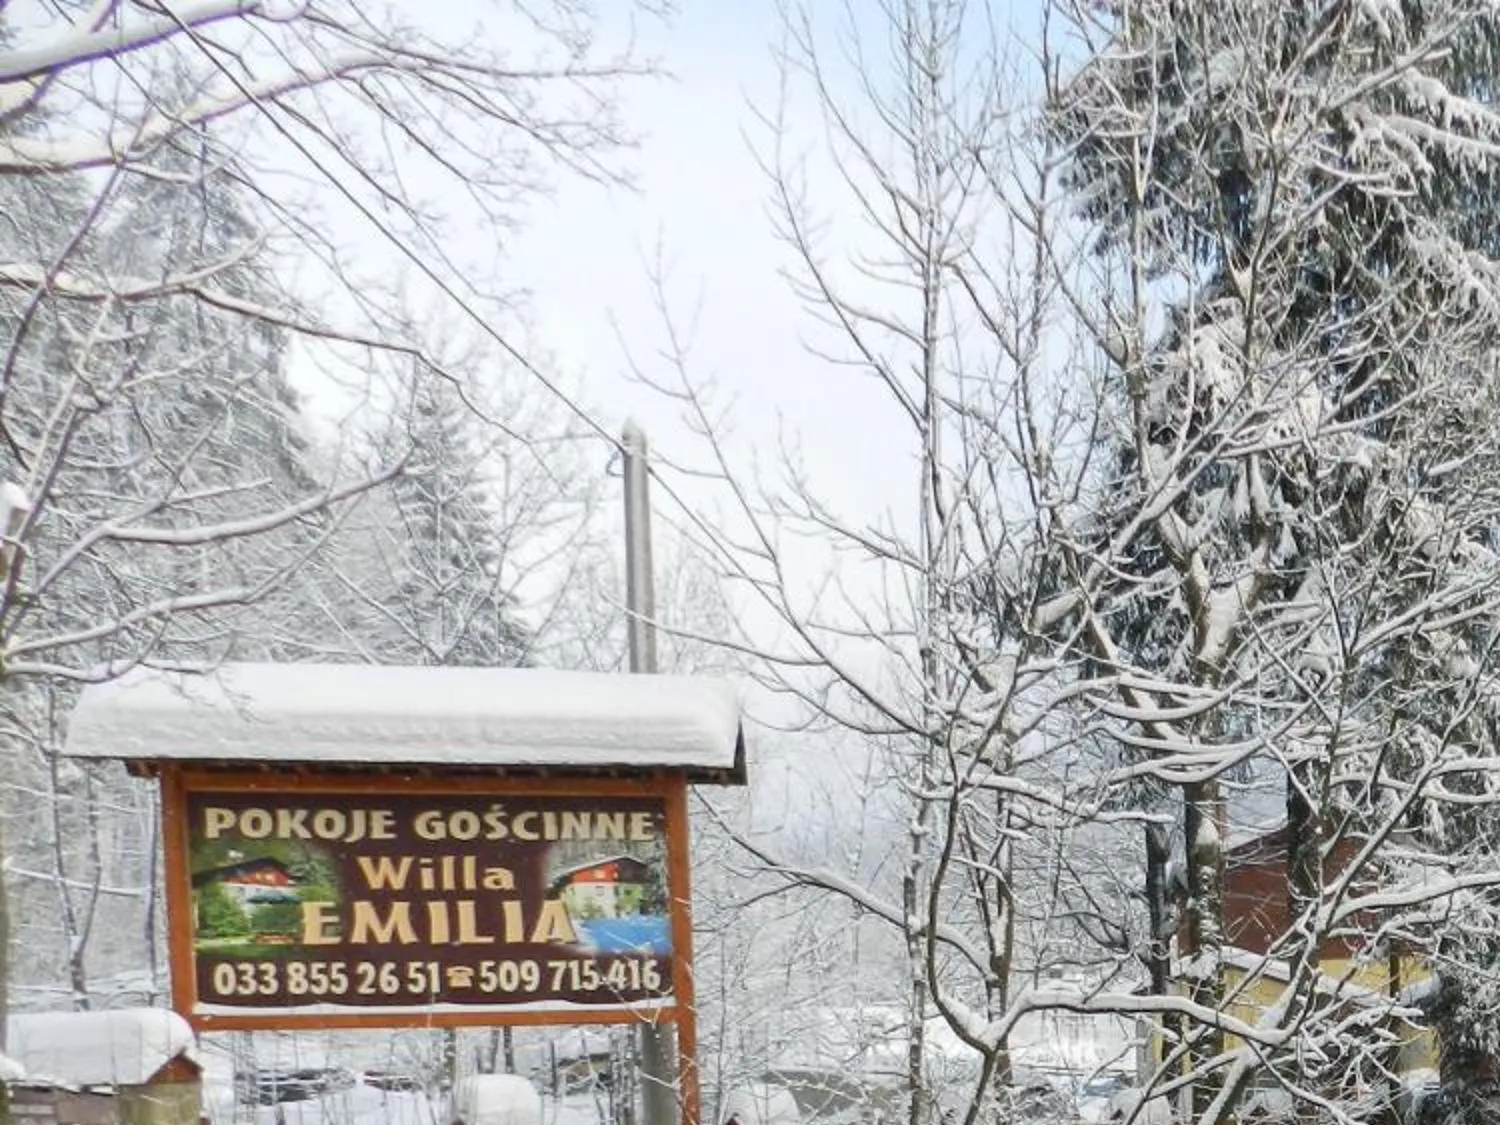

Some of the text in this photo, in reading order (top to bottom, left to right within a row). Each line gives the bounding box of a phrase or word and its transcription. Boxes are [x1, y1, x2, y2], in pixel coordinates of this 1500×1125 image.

[205, 803, 656, 842] POKOJE GOŚCINNE
[358, 856, 516, 891] Willa
[302, 900, 578, 945] EMILIA
[214, 959, 660, 995] 033 855 26 51 509 715 416
